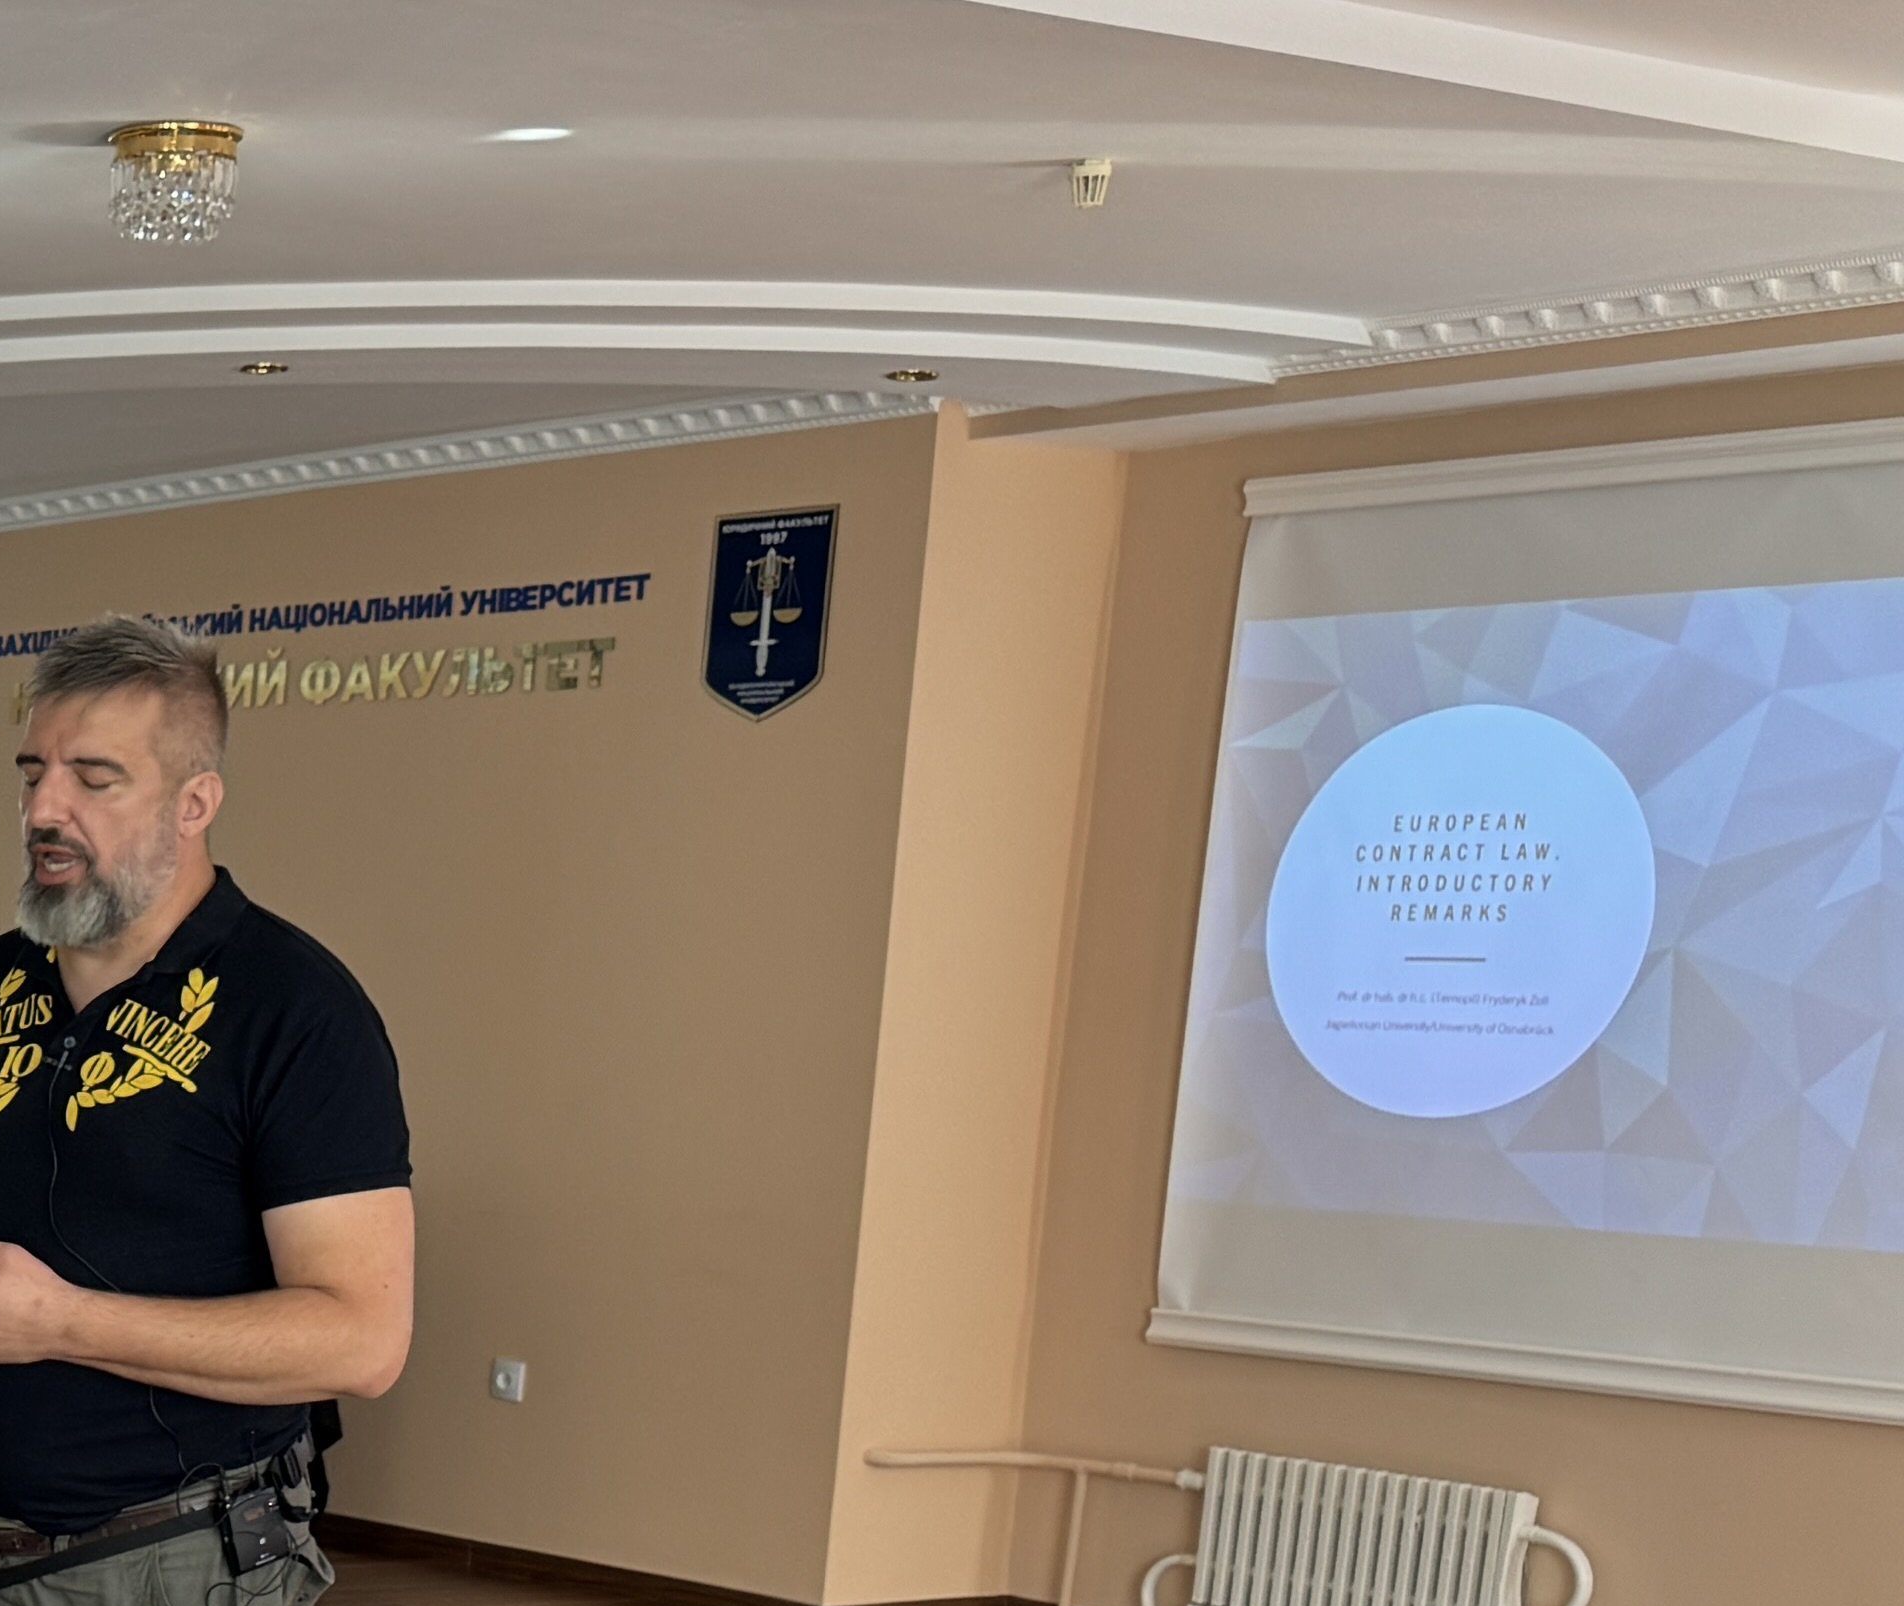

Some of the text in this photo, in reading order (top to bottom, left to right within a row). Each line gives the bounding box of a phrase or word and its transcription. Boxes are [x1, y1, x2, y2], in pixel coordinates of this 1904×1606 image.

[248, 586, 453, 633] НАЦІОНАЛЬНИЙ
[460, 573, 651, 617] УНІВЕРСИТЕТ
[300, 636, 616, 706] ФАКУЛЬТЕТ
[1393, 813, 1527, 833] EUROPEAN
[1355, 843, 1561, 862] CONTRACT LAW.
[1356, 874, 1552, 893] INTRODUCTORY
[1391, 904, 1508, 922] REMARKS
[106, 997, 212, 1076] VINCERE
